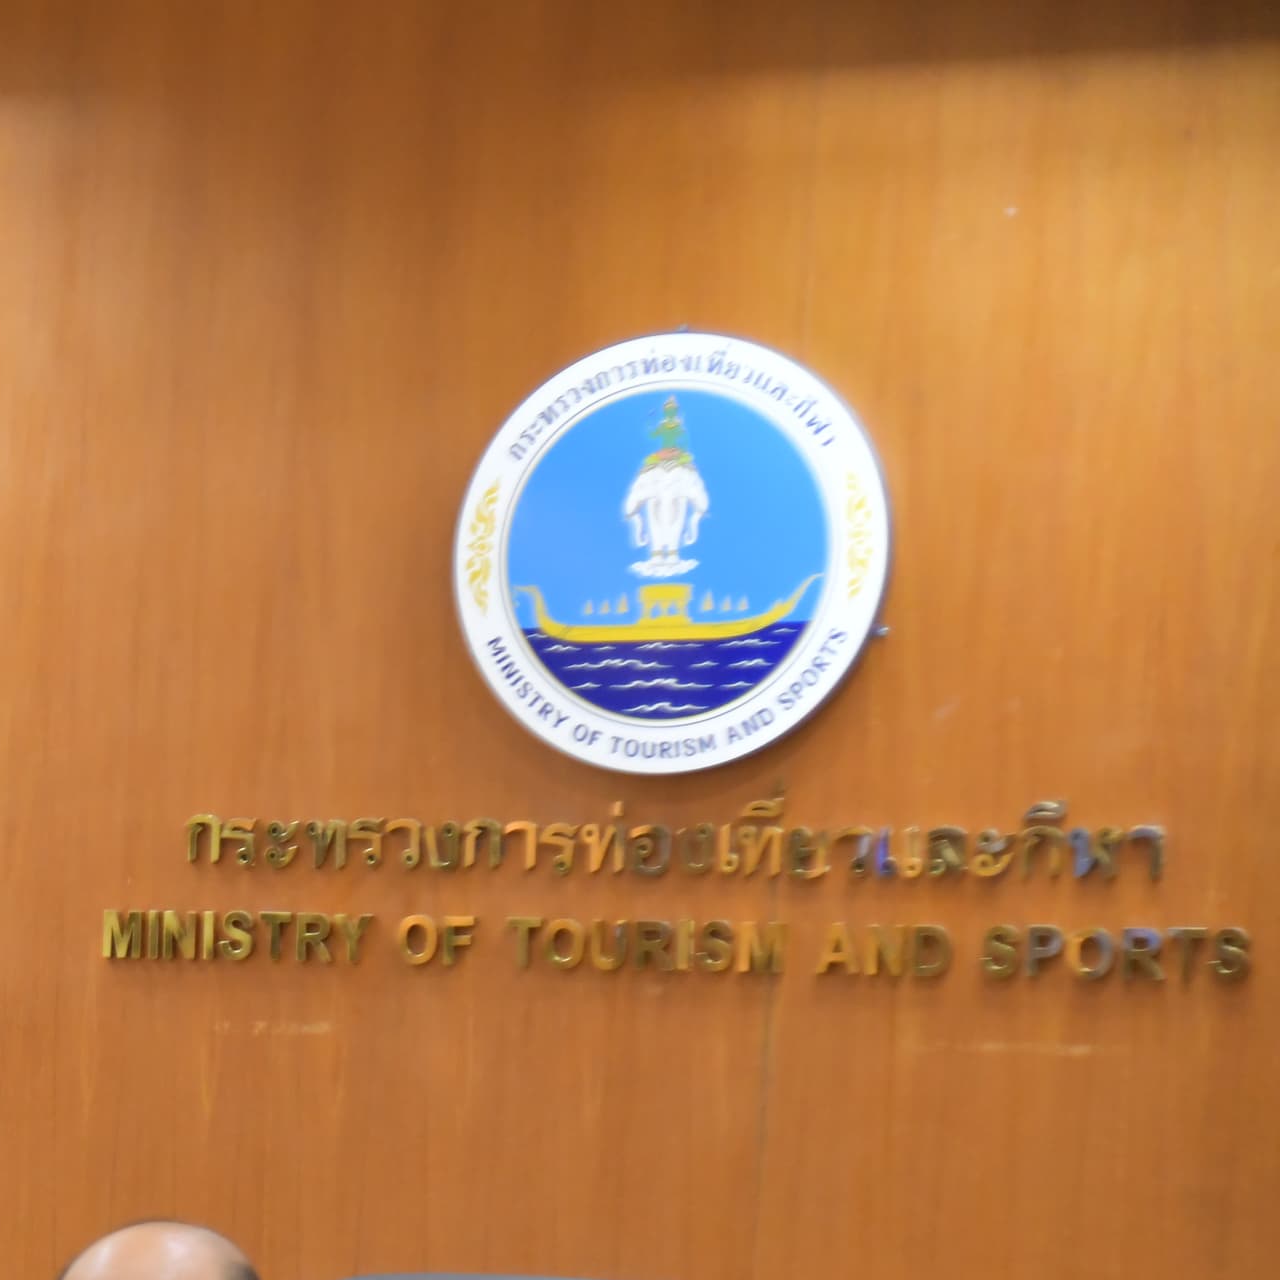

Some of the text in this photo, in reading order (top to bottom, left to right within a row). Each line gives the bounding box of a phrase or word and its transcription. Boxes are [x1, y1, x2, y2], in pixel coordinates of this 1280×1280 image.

[488, 628, 847, 759] MINISTRY OF TOURISM AND SPORTS
[102, 909, 1252, 980] MINISTRY OF TOURISM AND SPORTS
